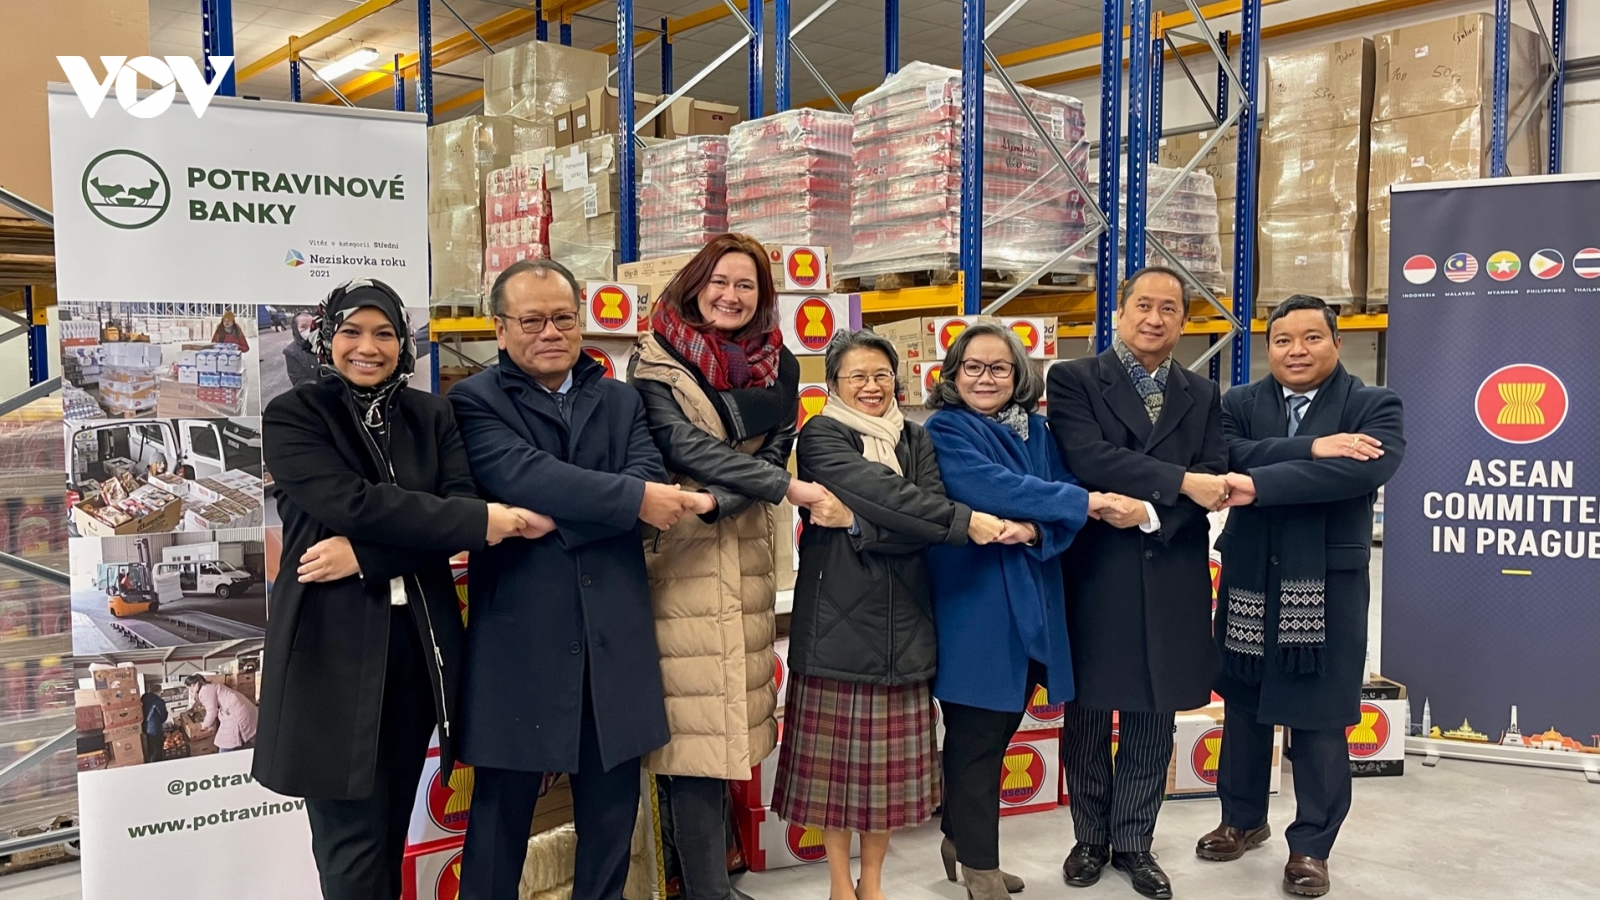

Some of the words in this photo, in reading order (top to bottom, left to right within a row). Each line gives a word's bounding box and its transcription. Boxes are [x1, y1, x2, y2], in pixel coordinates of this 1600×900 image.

[187, 167, 405, 201] POTRAVINOVÉ
[189, 199, 297, 225] BANKY
[309, 254, 378, 266] Neziskovka
[380, 257, 407, 267] roku
[309, 269, 330, 278] 2021
[1465, 459, 1573, 488] ASEAN
[1423, 491, 1600, 524] COMMITTE
[1433, 525, 1466, 554] IN
[1476, 527, 1600, 560] PRAGUE
[1001, 787, 1034, 798] asean
